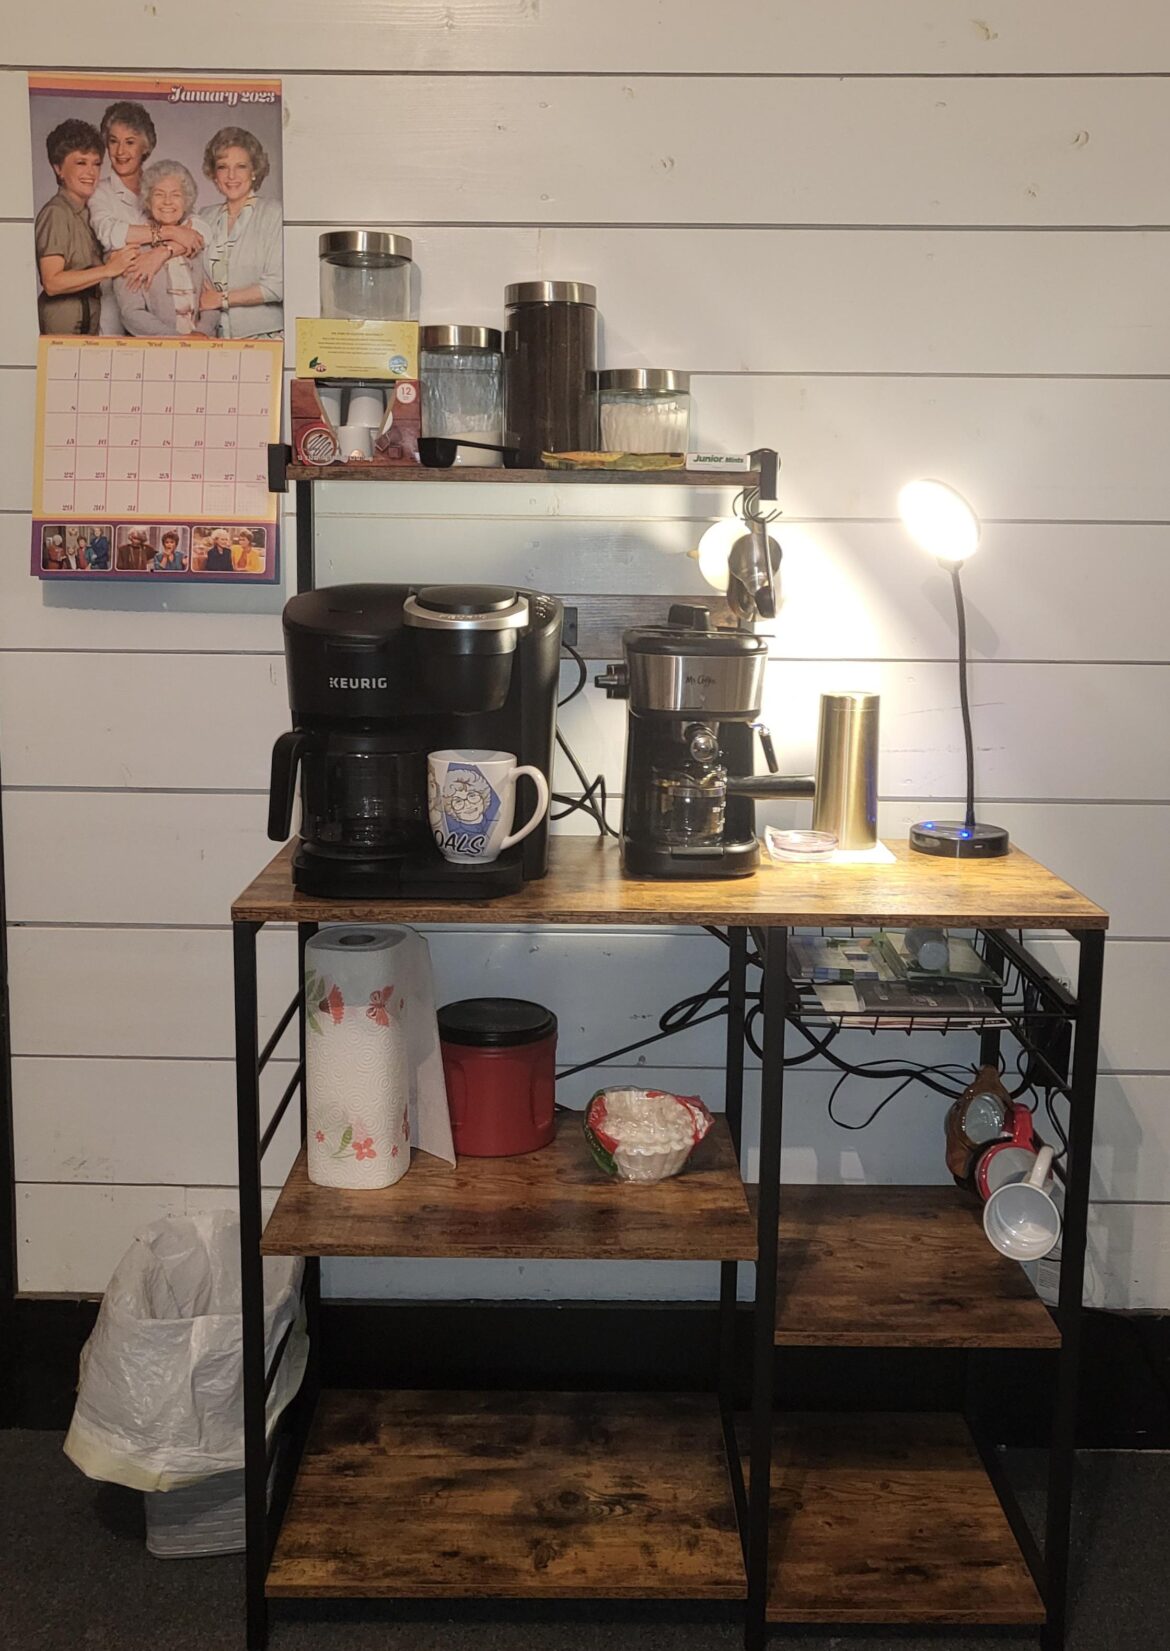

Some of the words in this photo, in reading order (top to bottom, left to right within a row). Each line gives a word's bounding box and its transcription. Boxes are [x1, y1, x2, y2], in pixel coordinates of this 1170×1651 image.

[168, 85, 239, 107] January
[401, 386, 412, 396] 12
[693, 454, 724, 463] Junior
[725, 456, 744, 464] Mints
[329, 677, 388, 689] KEURIG
